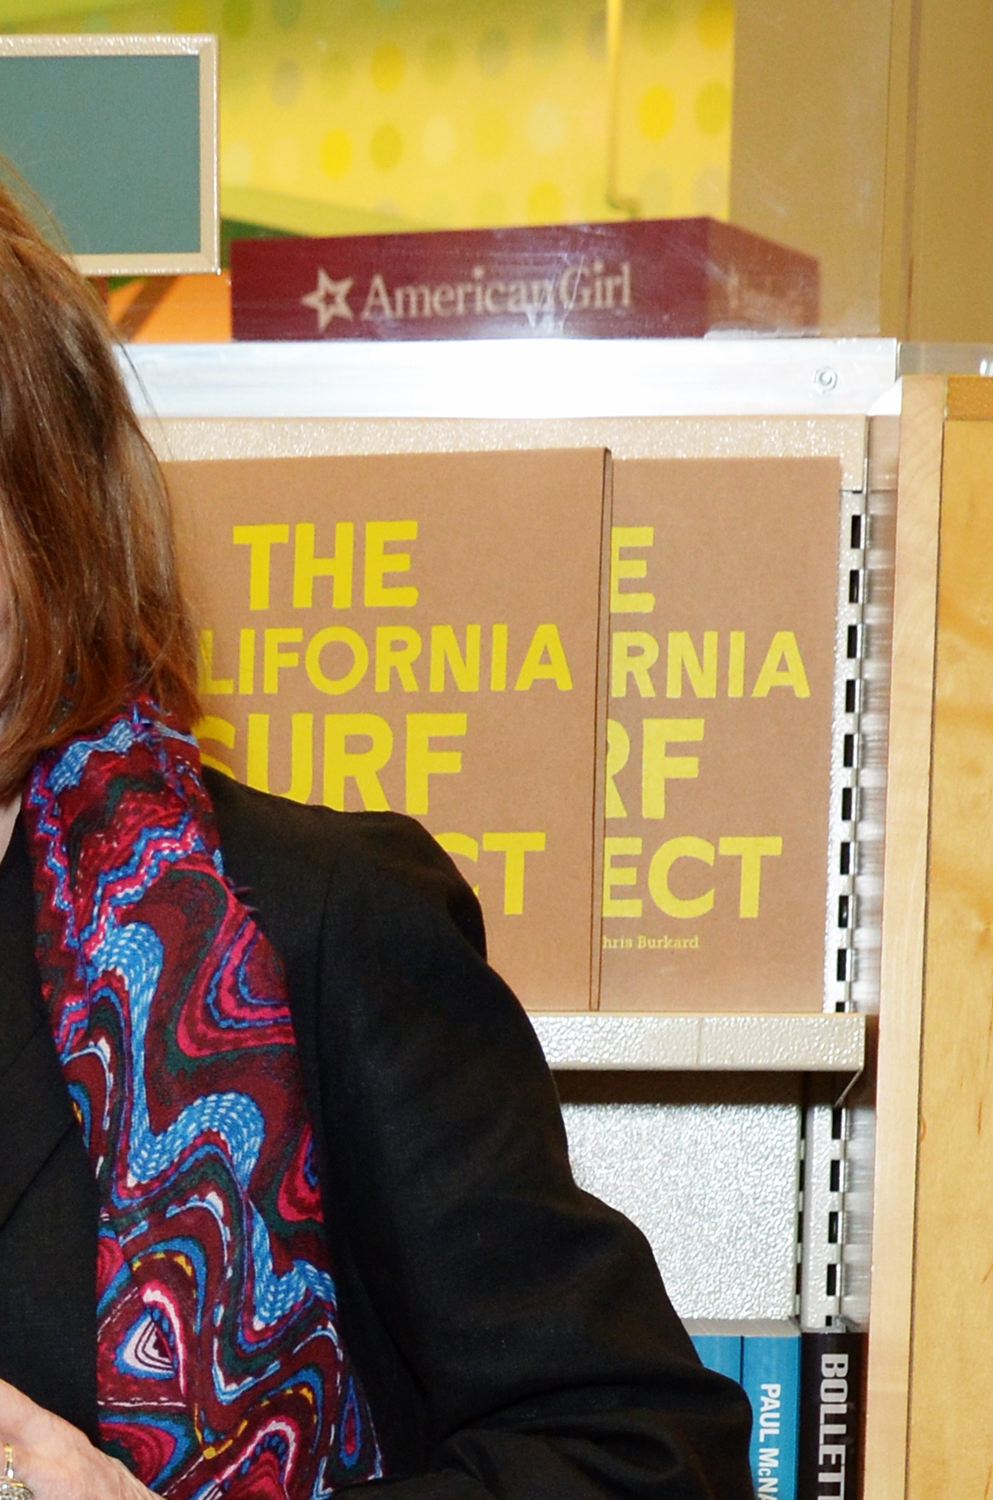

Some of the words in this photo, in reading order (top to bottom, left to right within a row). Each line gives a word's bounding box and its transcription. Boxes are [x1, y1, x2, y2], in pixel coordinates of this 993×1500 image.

[361, 266, 554, 322] American
[559, 259, 632, 311] Girl
[233, 521, 418, 610] THE
[603, 935, 634, 949] hris
[637, 935, 700, 949] Burkard
[758, 1383, 782, 1443] PAUL
